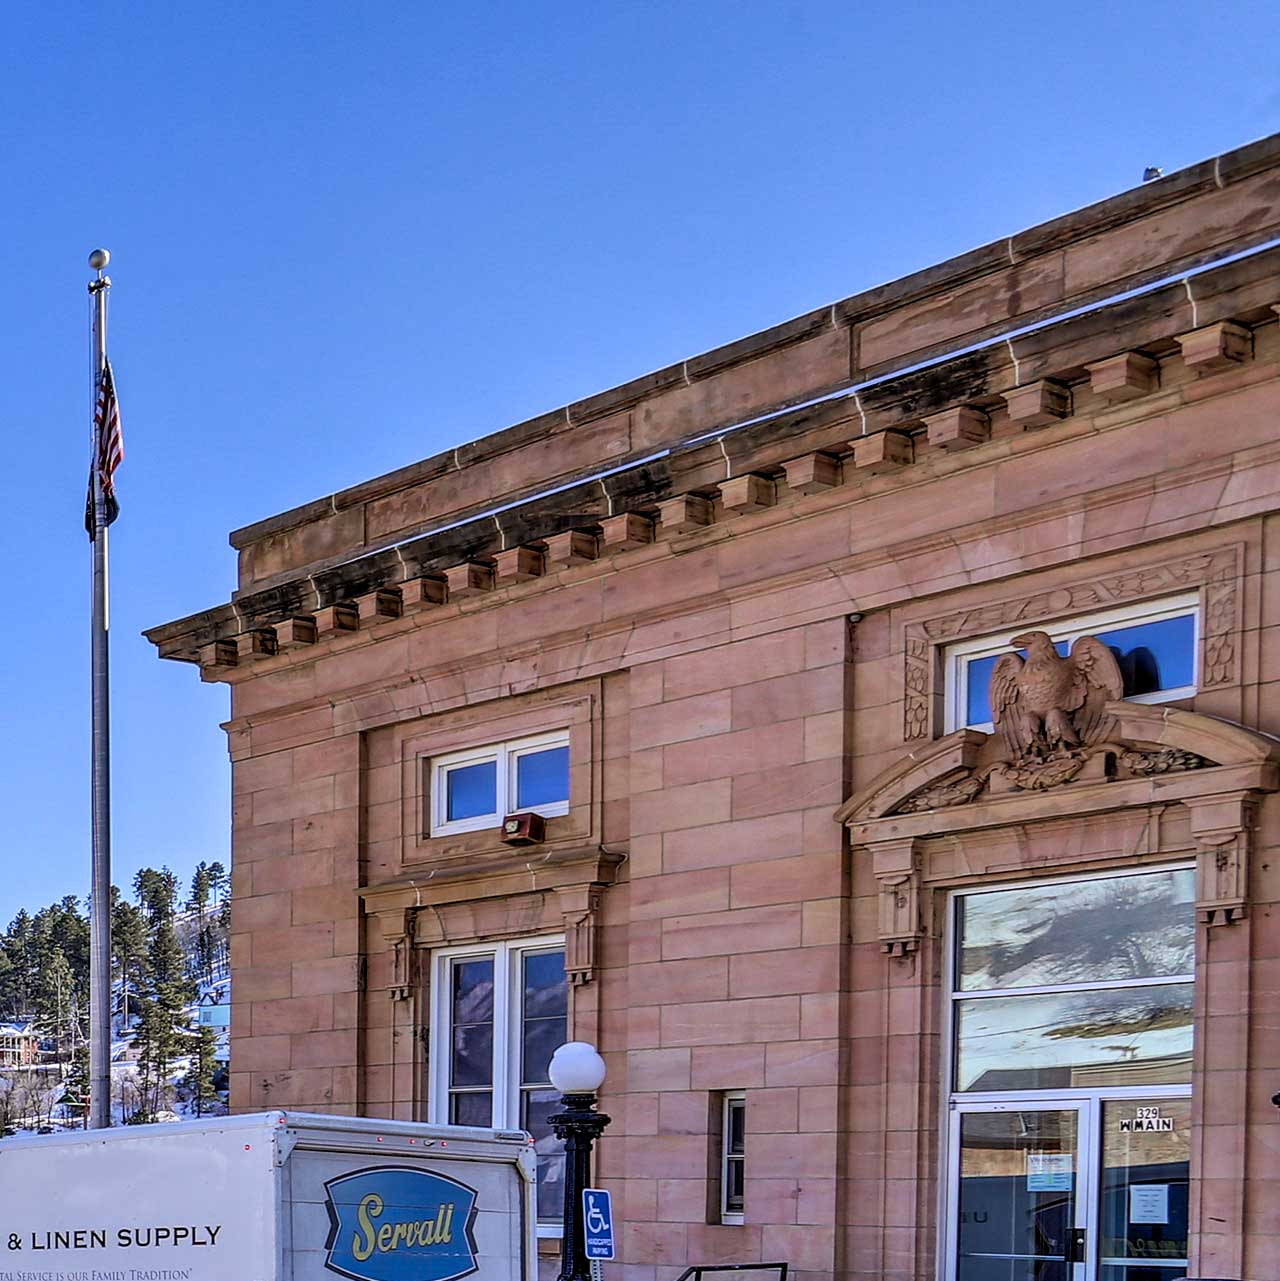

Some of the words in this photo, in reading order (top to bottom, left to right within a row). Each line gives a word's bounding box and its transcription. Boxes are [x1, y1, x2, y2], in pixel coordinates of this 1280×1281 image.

[1137, 1108, 1158, 1119] 329
[1120, 1120, 1130, 1131] W
[1134, 1119, 1172, 1131] MAIN
[352, 1193, 454, 1261] Servall
[7, 1233, 22, 1251] &
[32, 1229, 107, 1250] LINEN
[117, 1225, 222, 1248] SUPPLY
